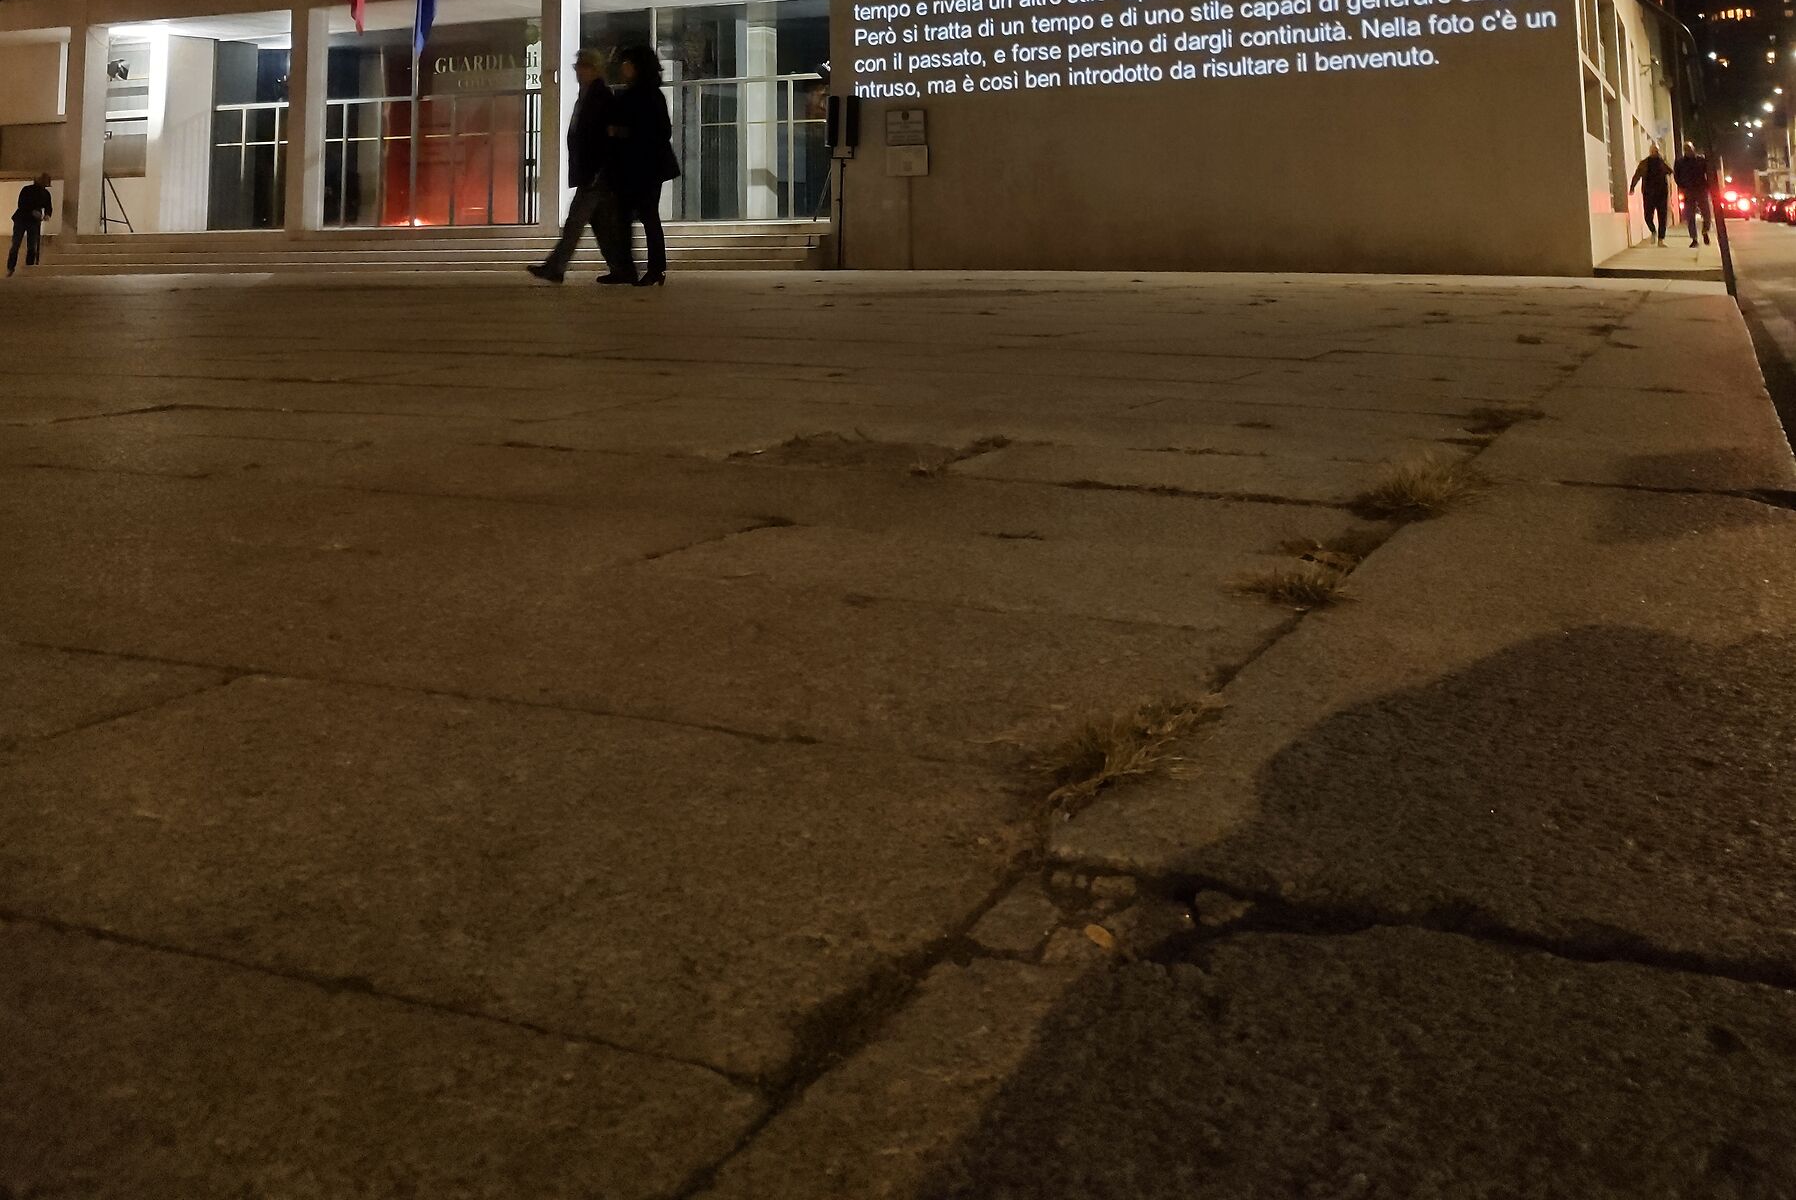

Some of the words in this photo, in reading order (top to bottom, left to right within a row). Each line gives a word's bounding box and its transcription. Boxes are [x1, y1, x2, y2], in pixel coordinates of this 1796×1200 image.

[853, 3, 911, 23] tempo
[915, 1, 928, 16] e
[854, 25, 897, 47] Però
[902, 23, 918, 43] si
[923, 21, 973, 42] tratta
[977, 17, 995, 38] di
[1000, 20, 1025, 36] un
[1030, 14, 1094, 35] tempo
[1100, 12, 1114, 29] e
[1119, 6, 1138, 27] di
[1144, 7, 1185, 26] uno
[1189, 0, 1234, 22] stile
[434, 53, 516, 73] GUARDIA
[854, 57, 887, 73] con
[893, 51, 903, 71] il
[908, 48, 987, 74] passato,
[993, 48, 1006, 64] e
[1011, 42, 1062, 63] forse
[1067, 36, 1144, 63] persino
[1148, 32, 1168, 54] di
[1173, 27, 1233, 55] dargli
[1239, 20, 1353, 48] continuità.
[1361, 16, 1422, 40] Nella
[1427, 13, 1475, 35] foto
[1480, 8, 1518, 32] c'è
[1525, 10, 1557, 29] un
[854, 80, 921, 99] intruso,
[927, 79, 957, 95] ma
[962, 73, 975, 93] è
[979, 70, 1019, 92] così
[1025, 69, 1061, 89] ben
[1068, 63, 1163, 86] introdotto
[1169, 59, 1197, 80] da
[1202, 55, 1290, 78] risultare
[1296, 52, 1308, 73] il
[1314, 46, 1440, 72] benvenuto.
